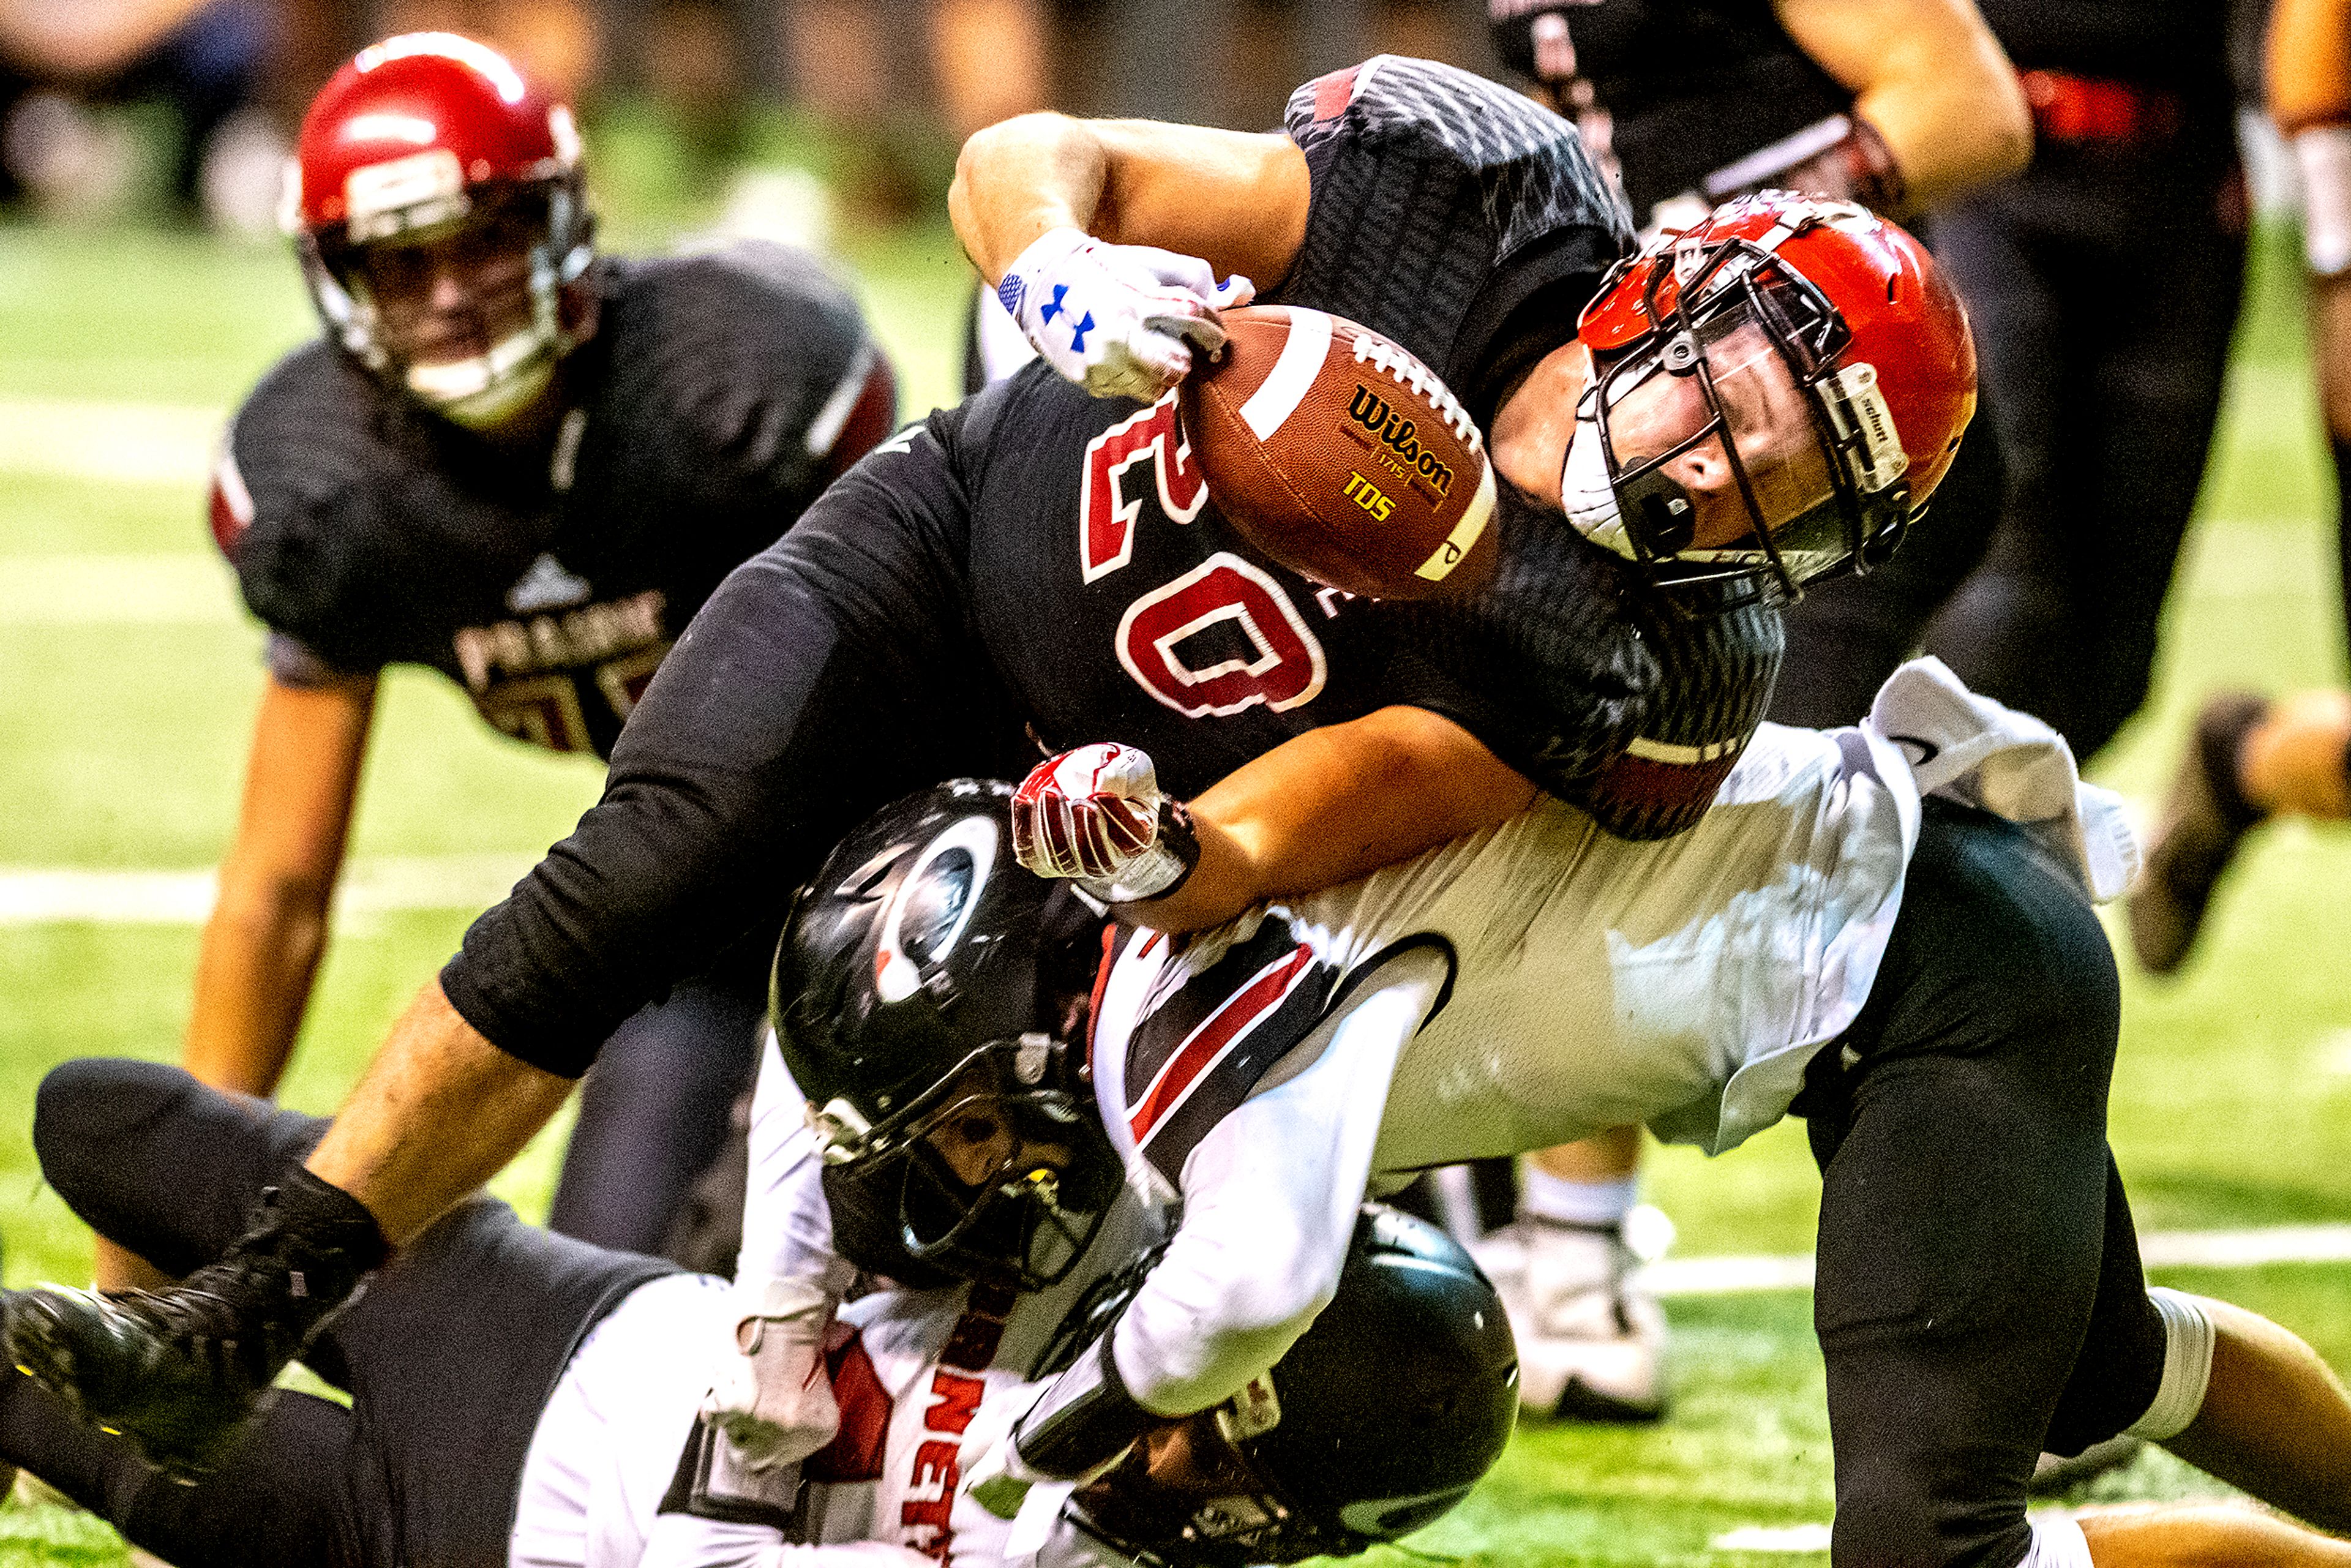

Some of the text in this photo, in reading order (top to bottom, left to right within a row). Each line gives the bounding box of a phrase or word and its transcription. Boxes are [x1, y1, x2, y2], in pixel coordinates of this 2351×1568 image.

[1348, 383, 1455, 495] Wilson
[1378, 454, 1406, 480] 1715
[1342, 470, 1396, 522] TDS
[1079, 387, 1329, 719] 20
